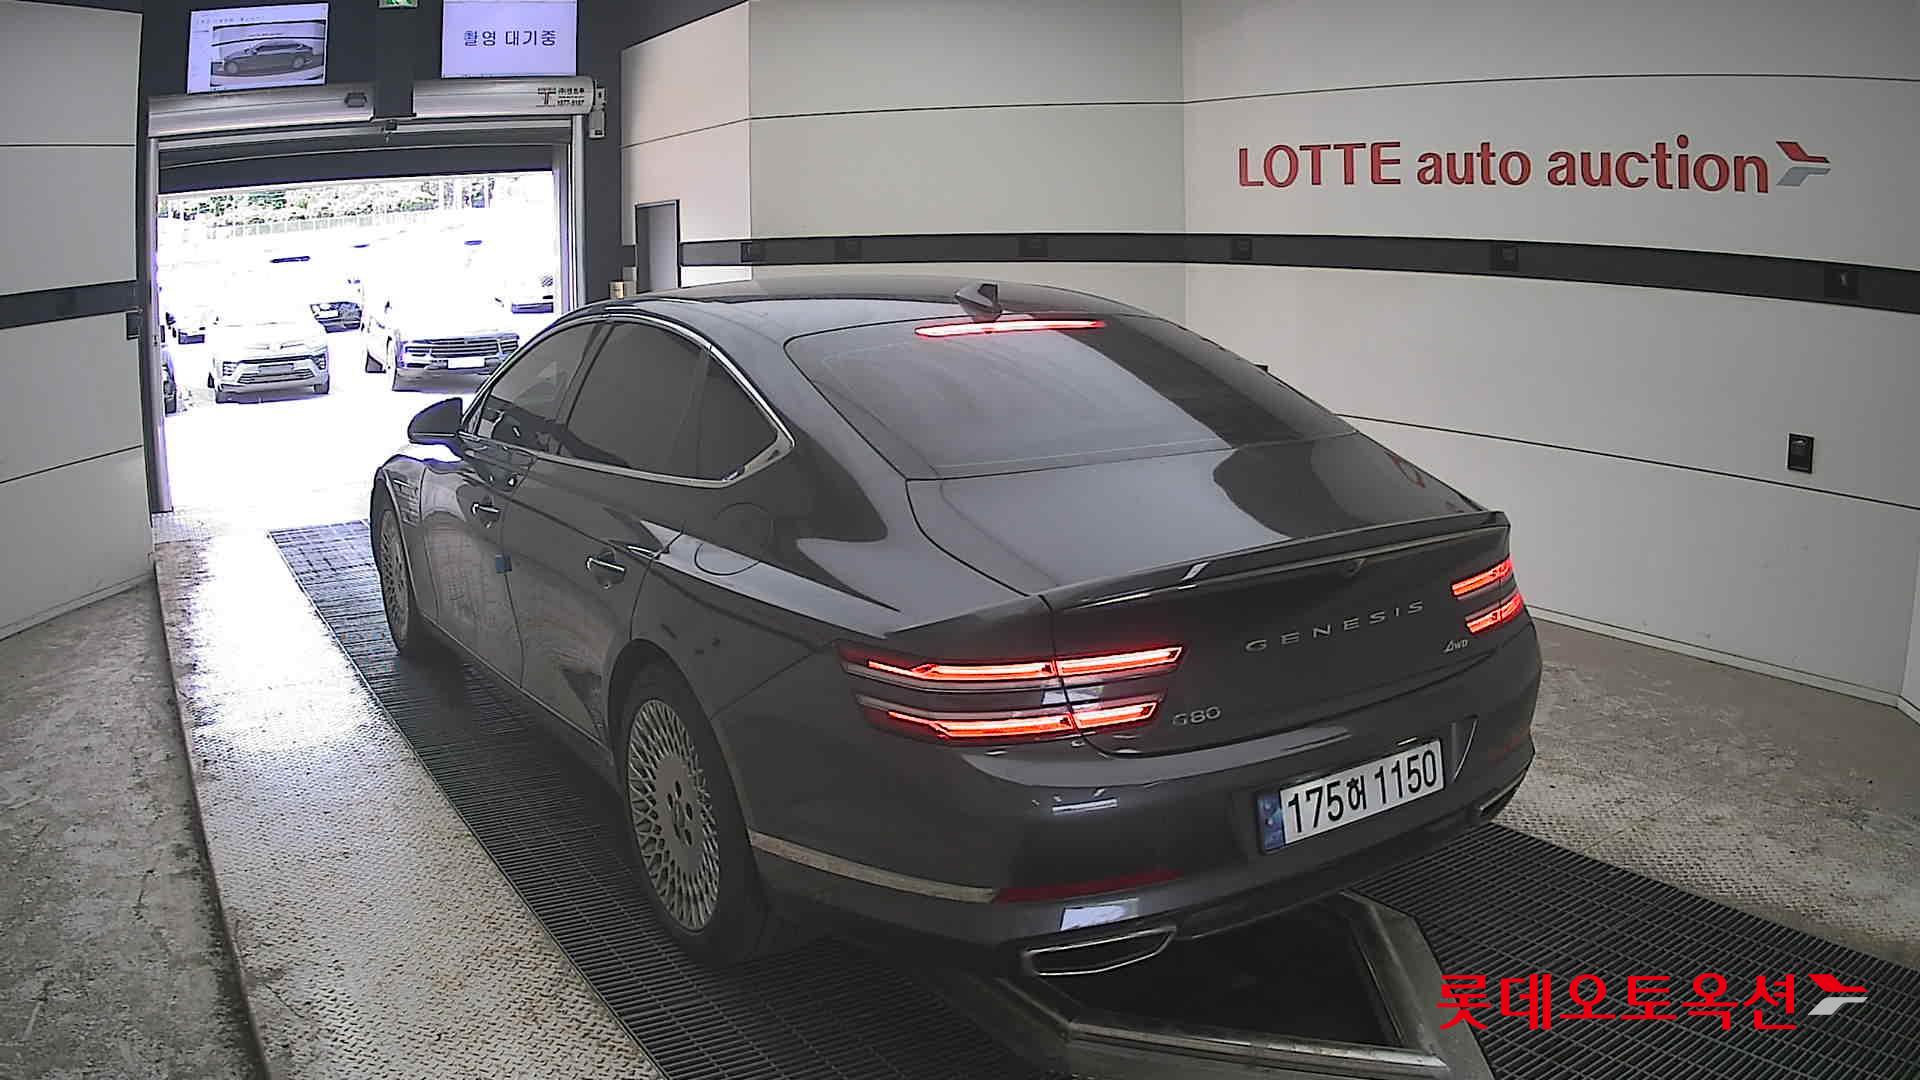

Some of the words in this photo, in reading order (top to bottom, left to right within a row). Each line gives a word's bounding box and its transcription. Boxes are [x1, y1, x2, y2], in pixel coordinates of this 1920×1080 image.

[505, 30, 556, 47] 대기중
[1238, 141, 1401, 187] LOTTE
[1416, 142, 1532, 186] auto
[1547, 134, 1769, 194] auction
[1245, 600, 1425, 651] GENESIS
[1172, 706, 1221, 726] G80
[1287, 775, 1367, 834] 175허
[1374, 750, 1437, 805] 1150
